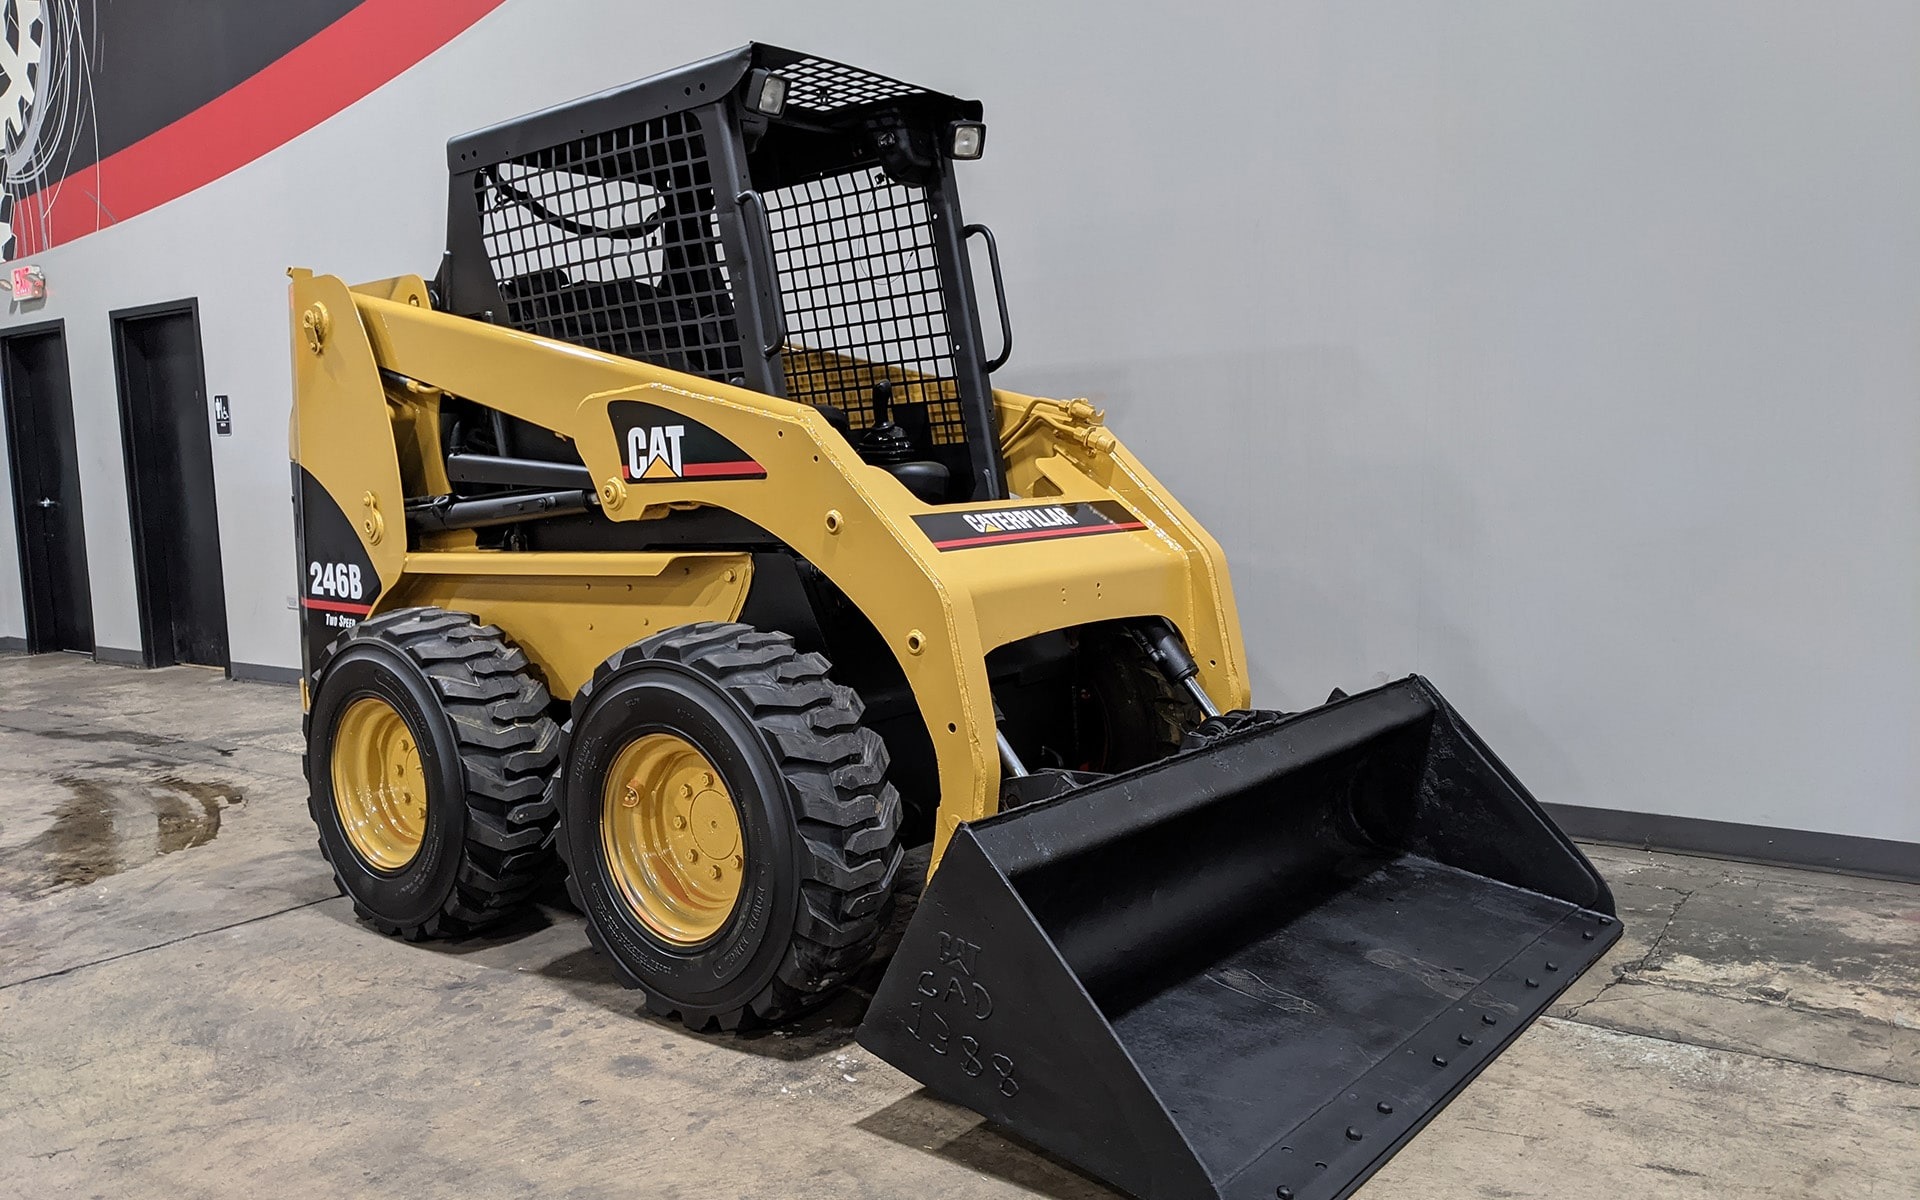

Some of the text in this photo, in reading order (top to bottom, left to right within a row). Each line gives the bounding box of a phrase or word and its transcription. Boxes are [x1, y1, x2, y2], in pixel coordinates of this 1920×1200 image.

[627, 425, 685, 479] CAT
[962, 507, 1078, 533] CATERPILLAR
[310, 561, 363, 600] 246B
